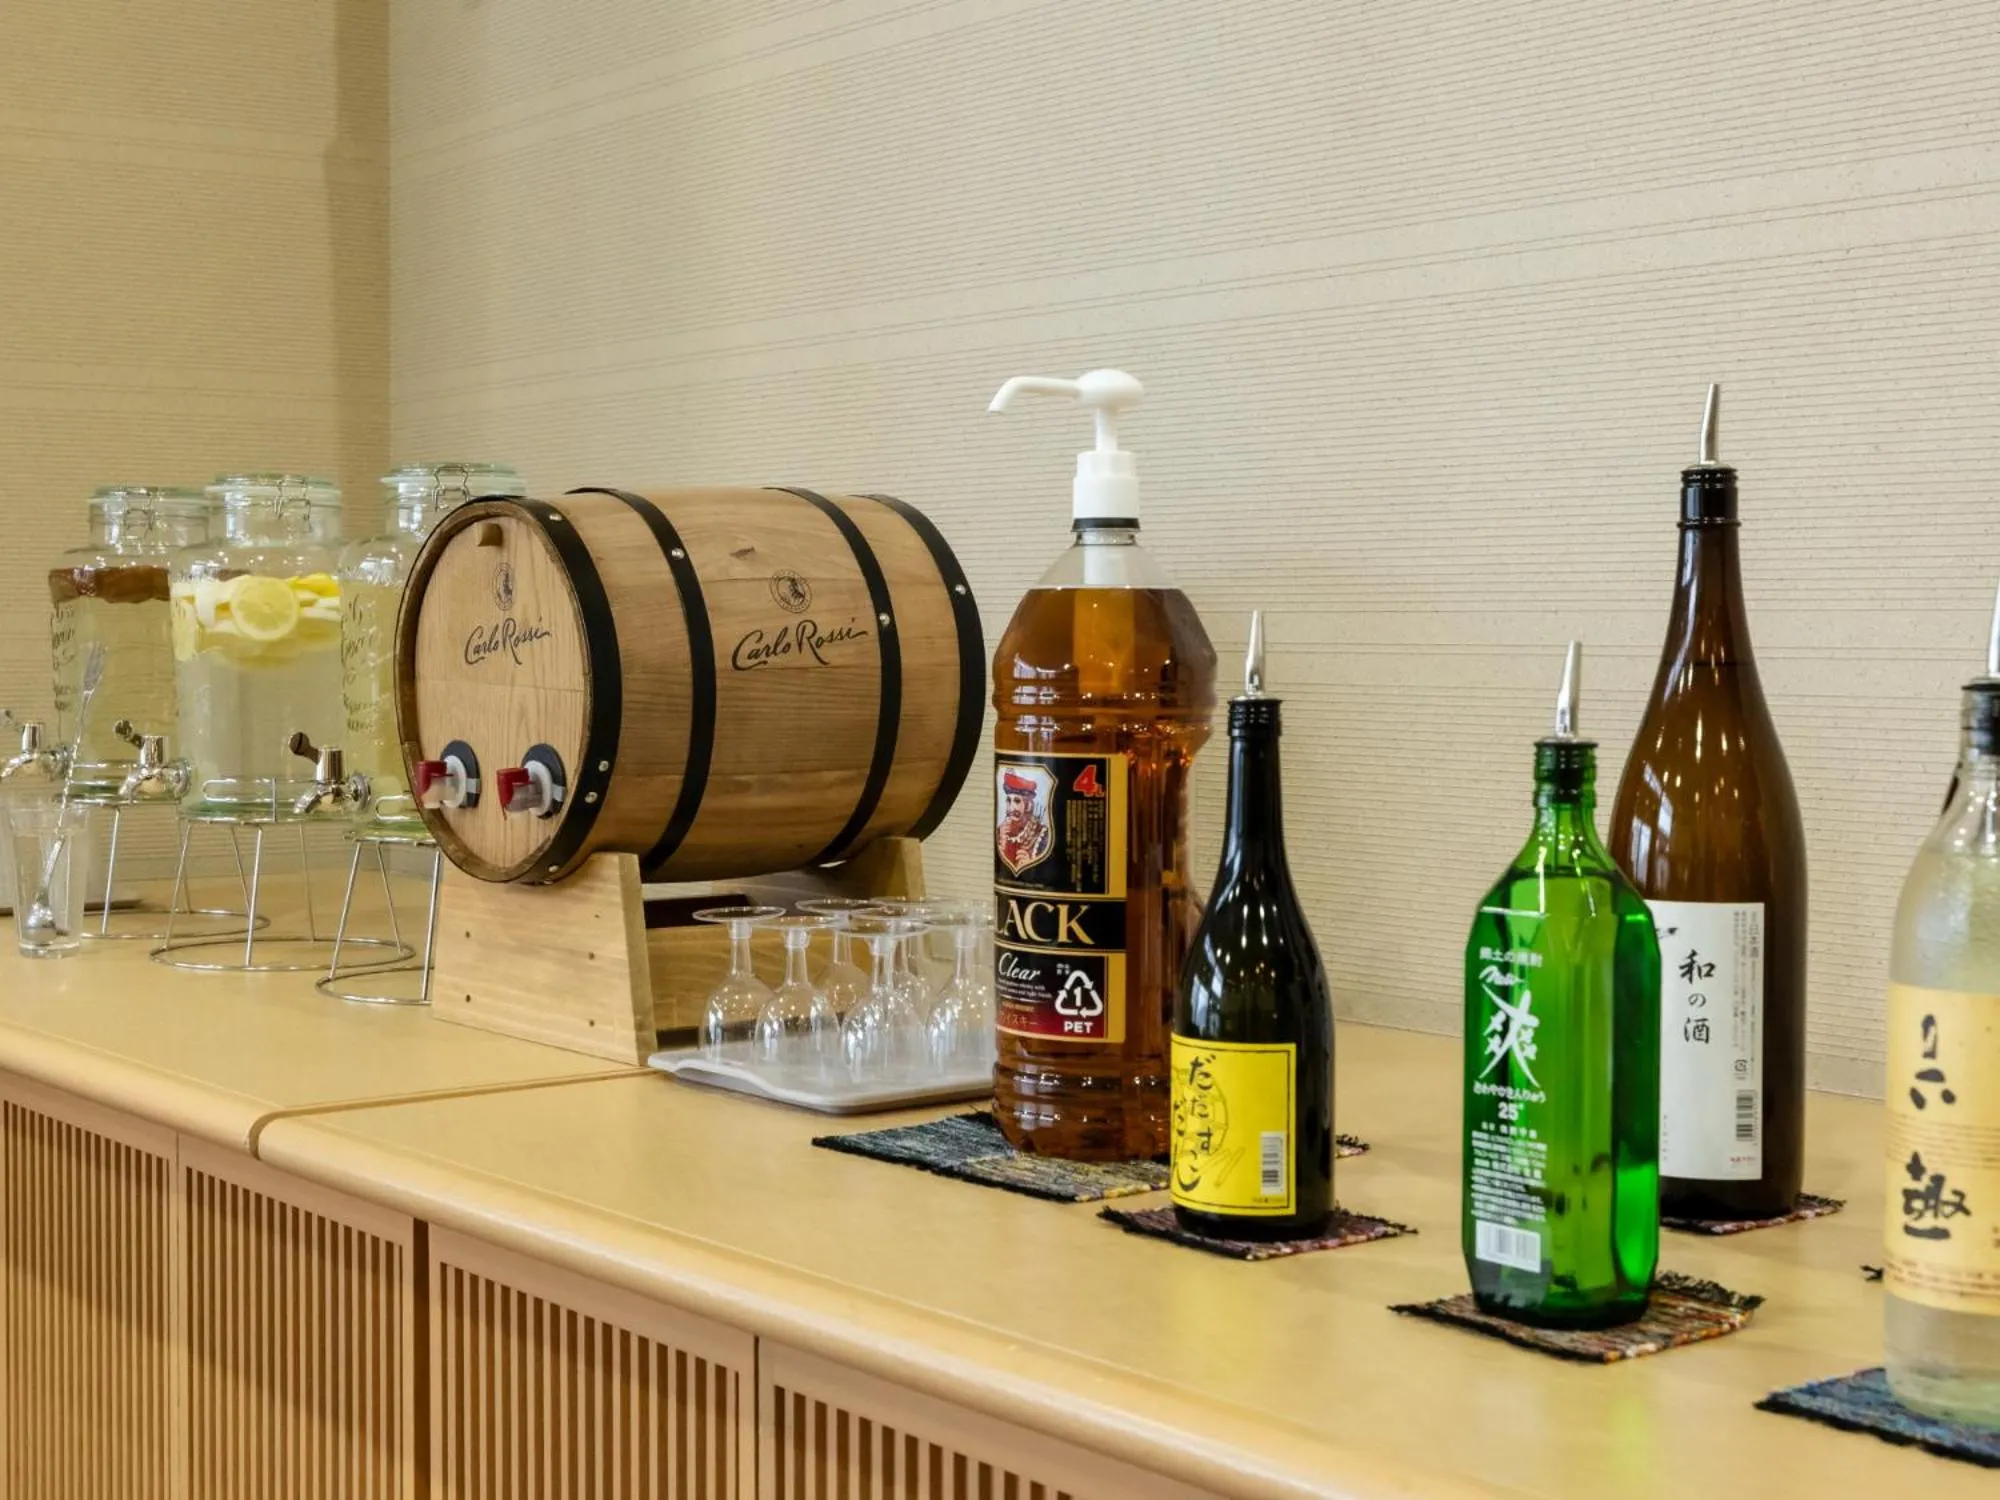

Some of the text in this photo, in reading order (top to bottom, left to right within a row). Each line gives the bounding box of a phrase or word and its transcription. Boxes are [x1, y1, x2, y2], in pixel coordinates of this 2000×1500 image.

[464, 616, 550, 666] Carlo Rossi
[732, 616, 867, 671] Carlo Rossi
[998, 899, 1095, 945] ACK
[998, 952, 1041, 981] Clear
[1679, 949, 1716, 1044] 和の酒
[1063, 1020, 1094, 1034] PET
